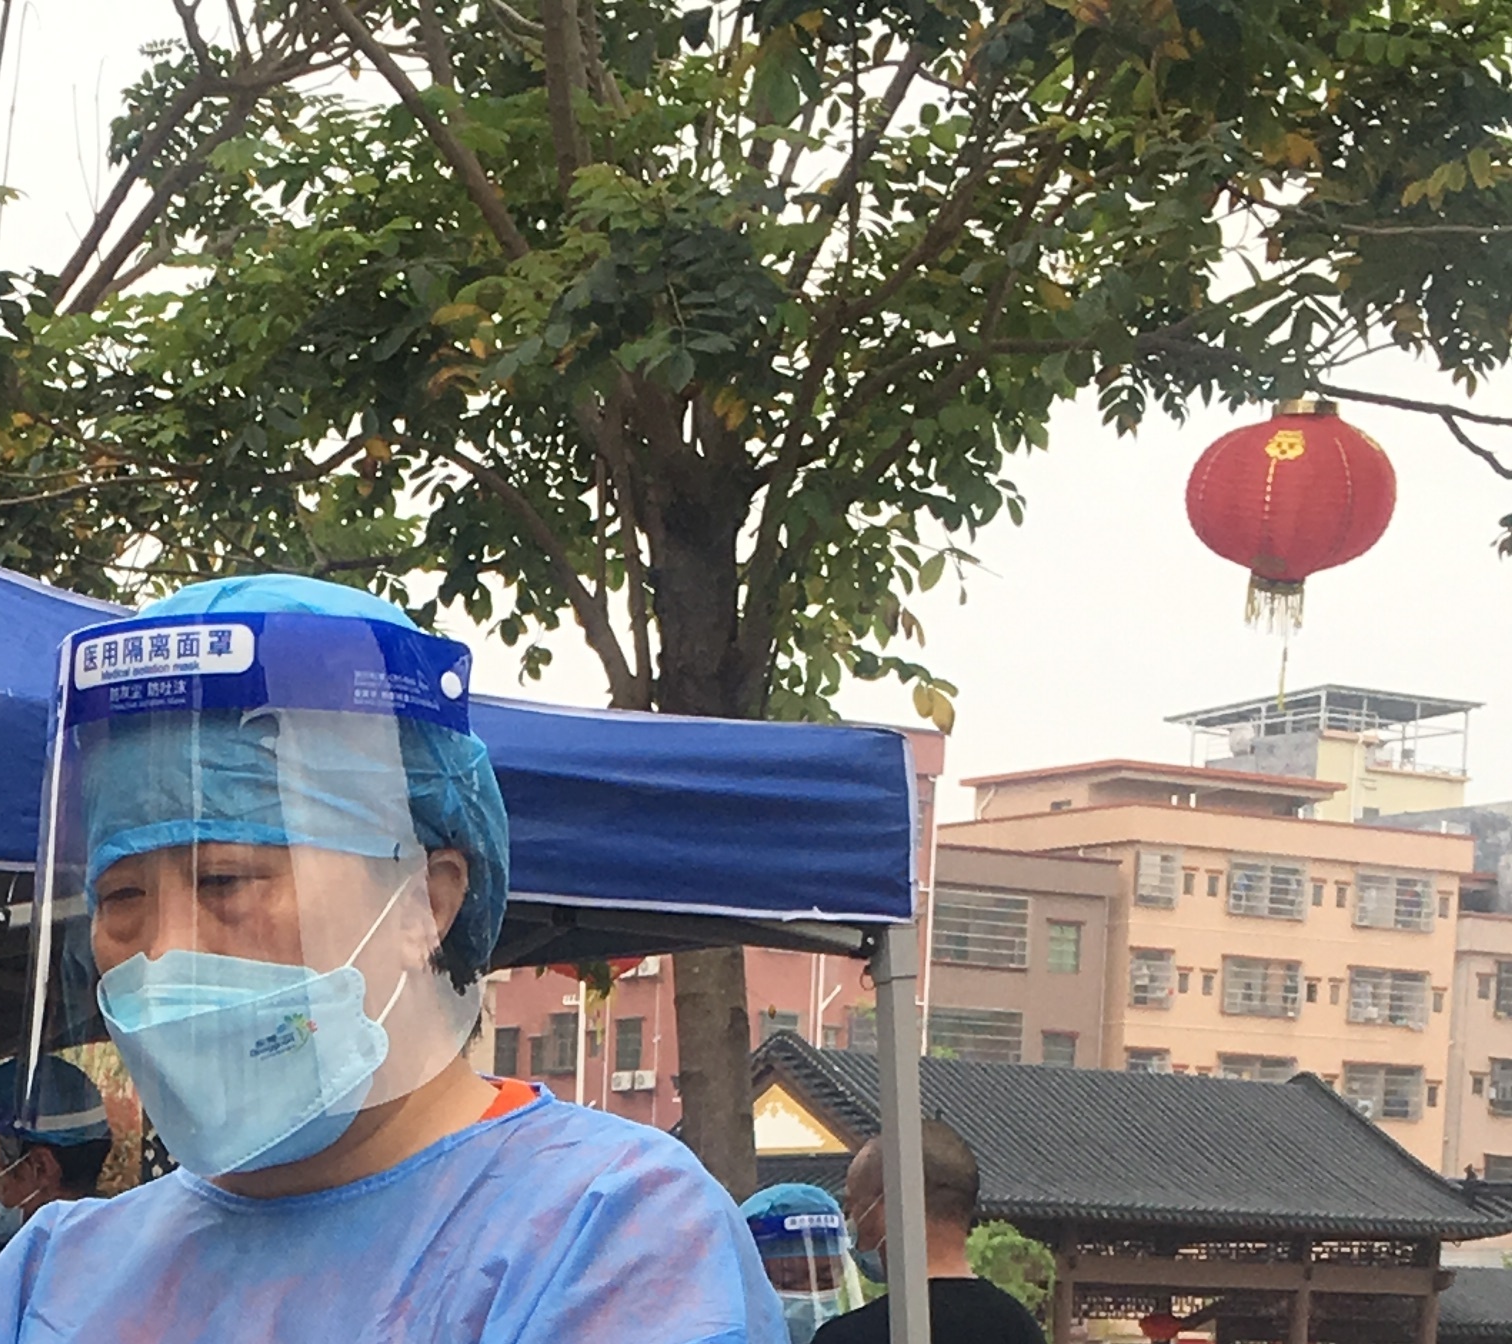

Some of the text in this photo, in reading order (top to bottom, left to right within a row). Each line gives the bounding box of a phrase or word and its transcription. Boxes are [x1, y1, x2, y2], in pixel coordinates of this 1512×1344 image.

[84, 630, 233, 672] 医用隔离面罩
